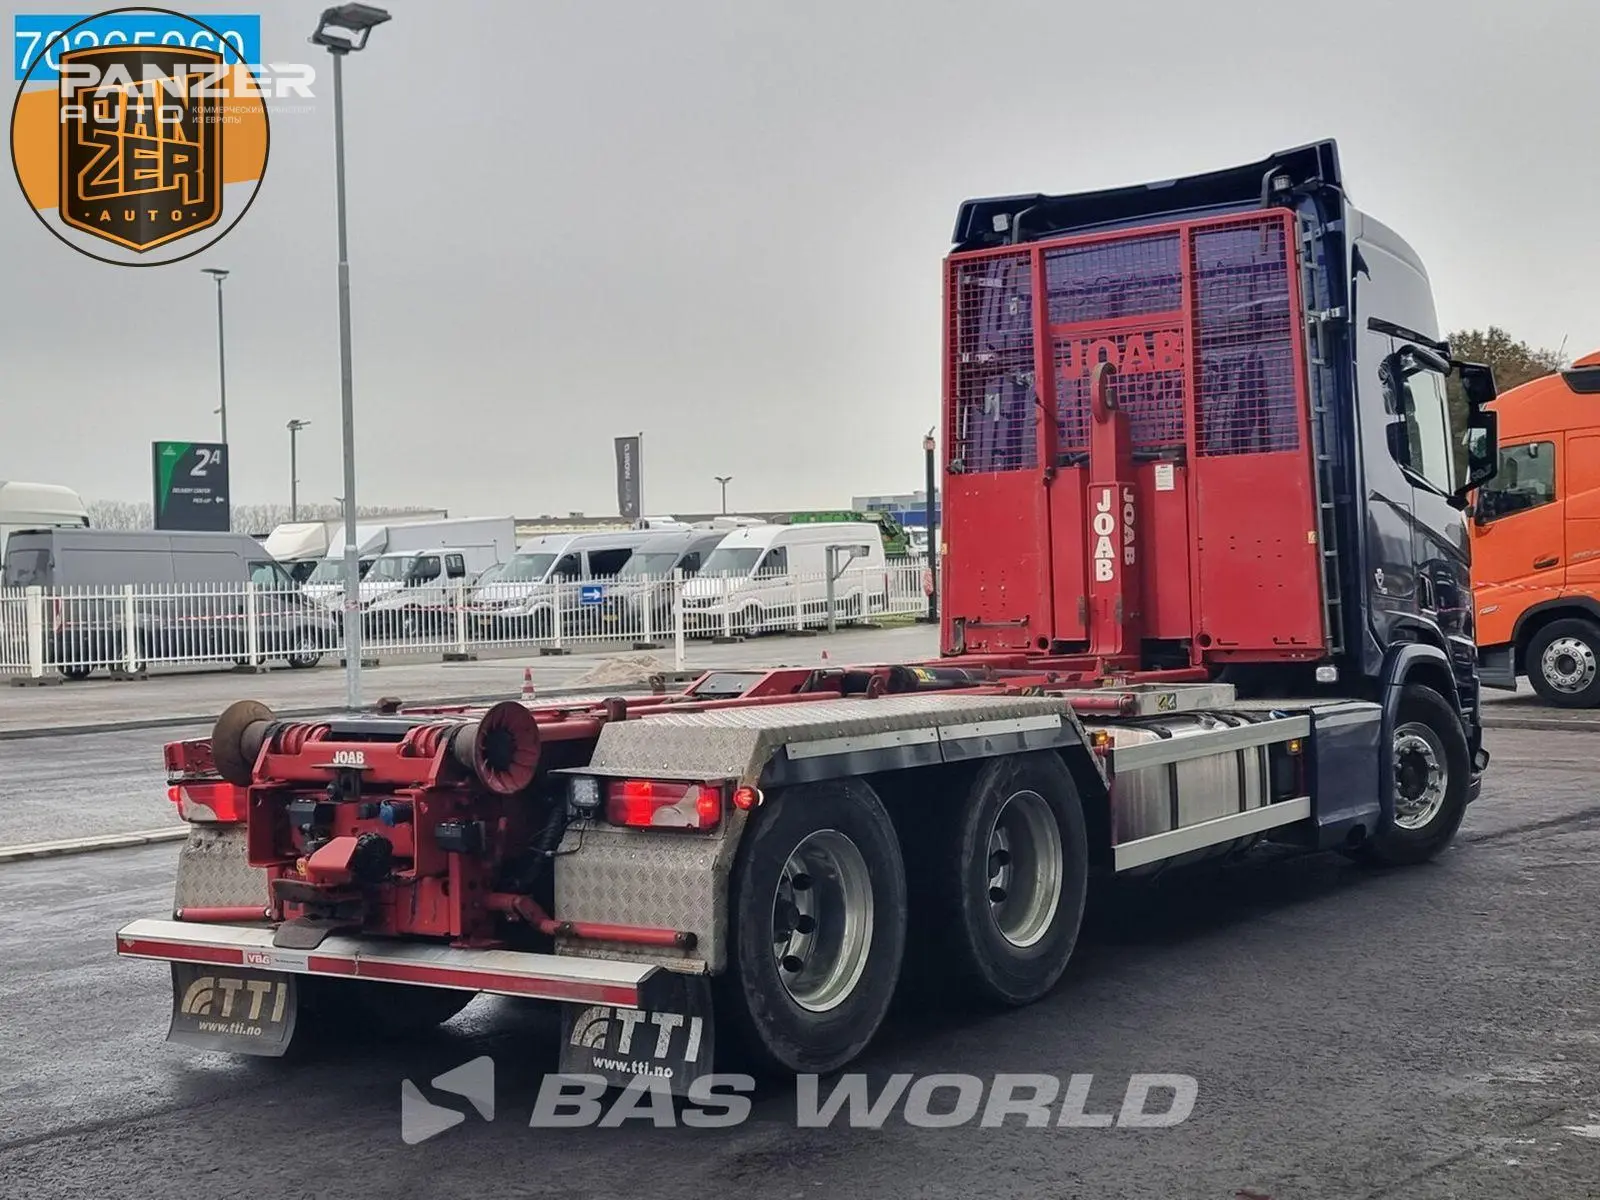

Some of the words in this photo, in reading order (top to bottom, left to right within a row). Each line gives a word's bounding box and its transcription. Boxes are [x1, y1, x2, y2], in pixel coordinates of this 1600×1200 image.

[1062, 332, 1181, 379] JOAB
[1094, 489, 1115, 581] JOAB
[1123, 487, 1135, 566] JOAB
[333, 751, 364, 764] JOAB
[248, 954, 270, 965] VBG
[218, 977, 287, 1022] TTI
[199, 1021, 262, 1036] www.tti.no
[616, 1008, 703, 1062] TTI
[592, 1056, 673, 1079] www.tti.no
